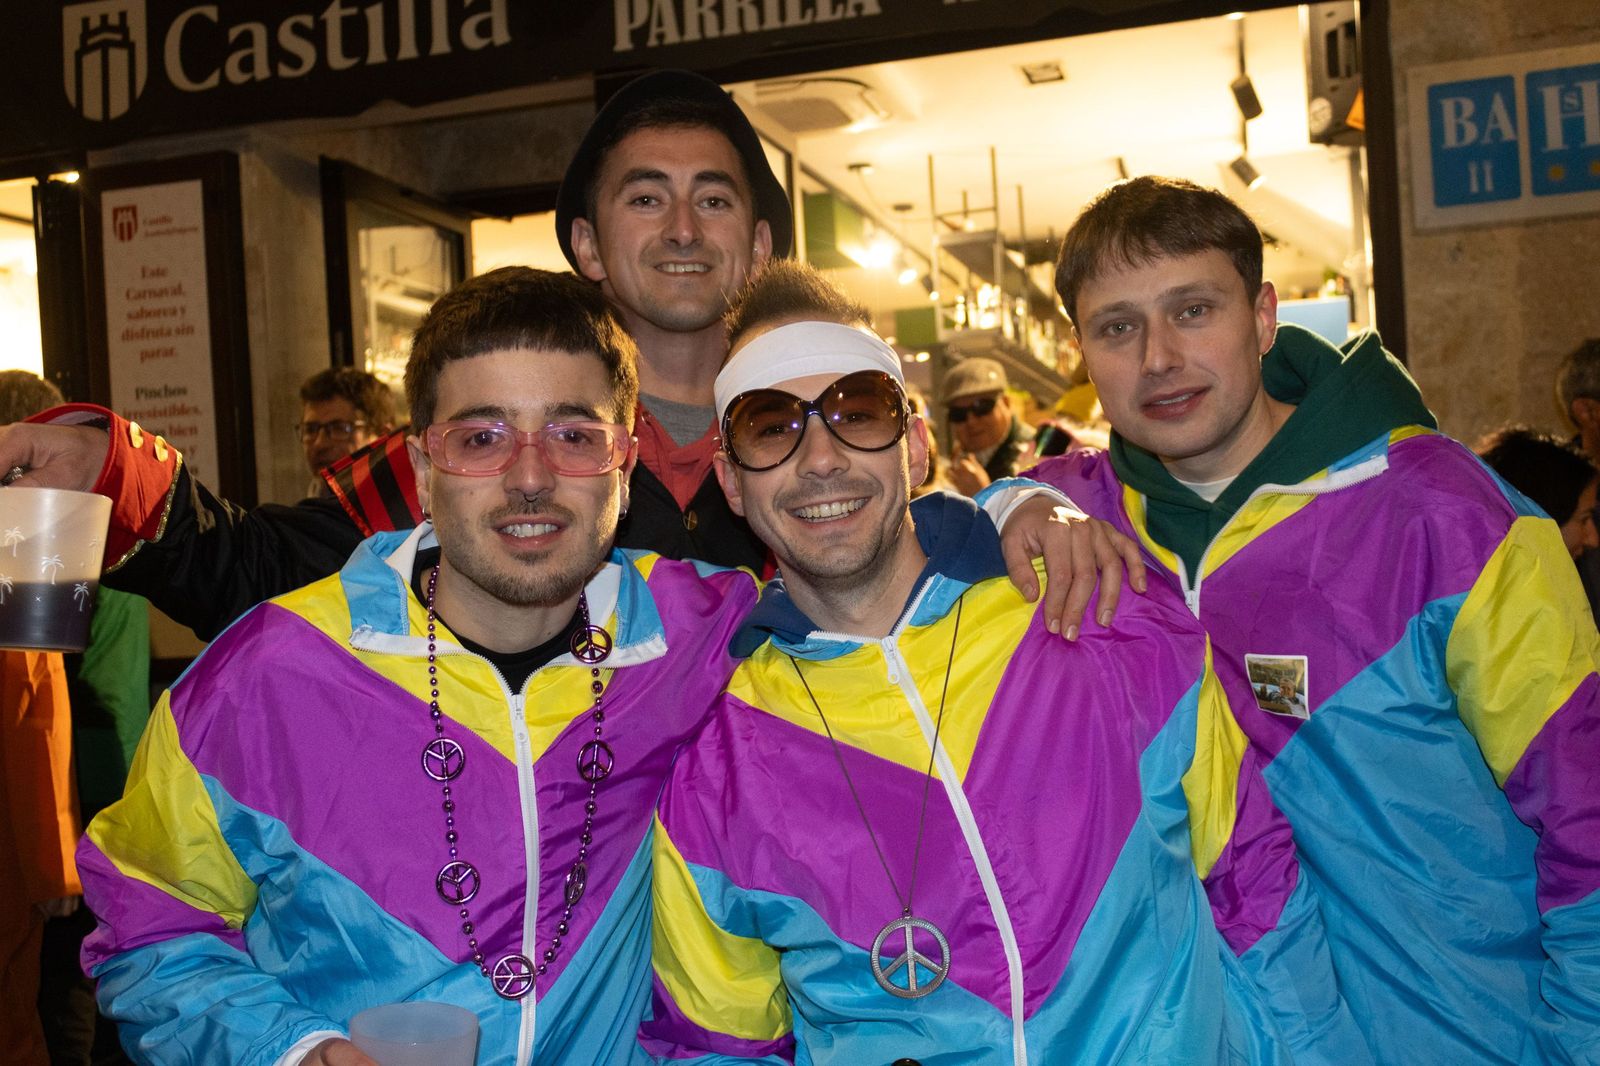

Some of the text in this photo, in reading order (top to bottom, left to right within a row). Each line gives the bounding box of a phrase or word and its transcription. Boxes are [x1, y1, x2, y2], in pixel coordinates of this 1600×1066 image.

[164, 0, 511, 92] Castilla
[613, 0, 881, 51] PARR
[1440, 91, 1517, 150] BA
[121, 325, 173, 342] disfruta
[135, 384, 188, 400] Pinchos
